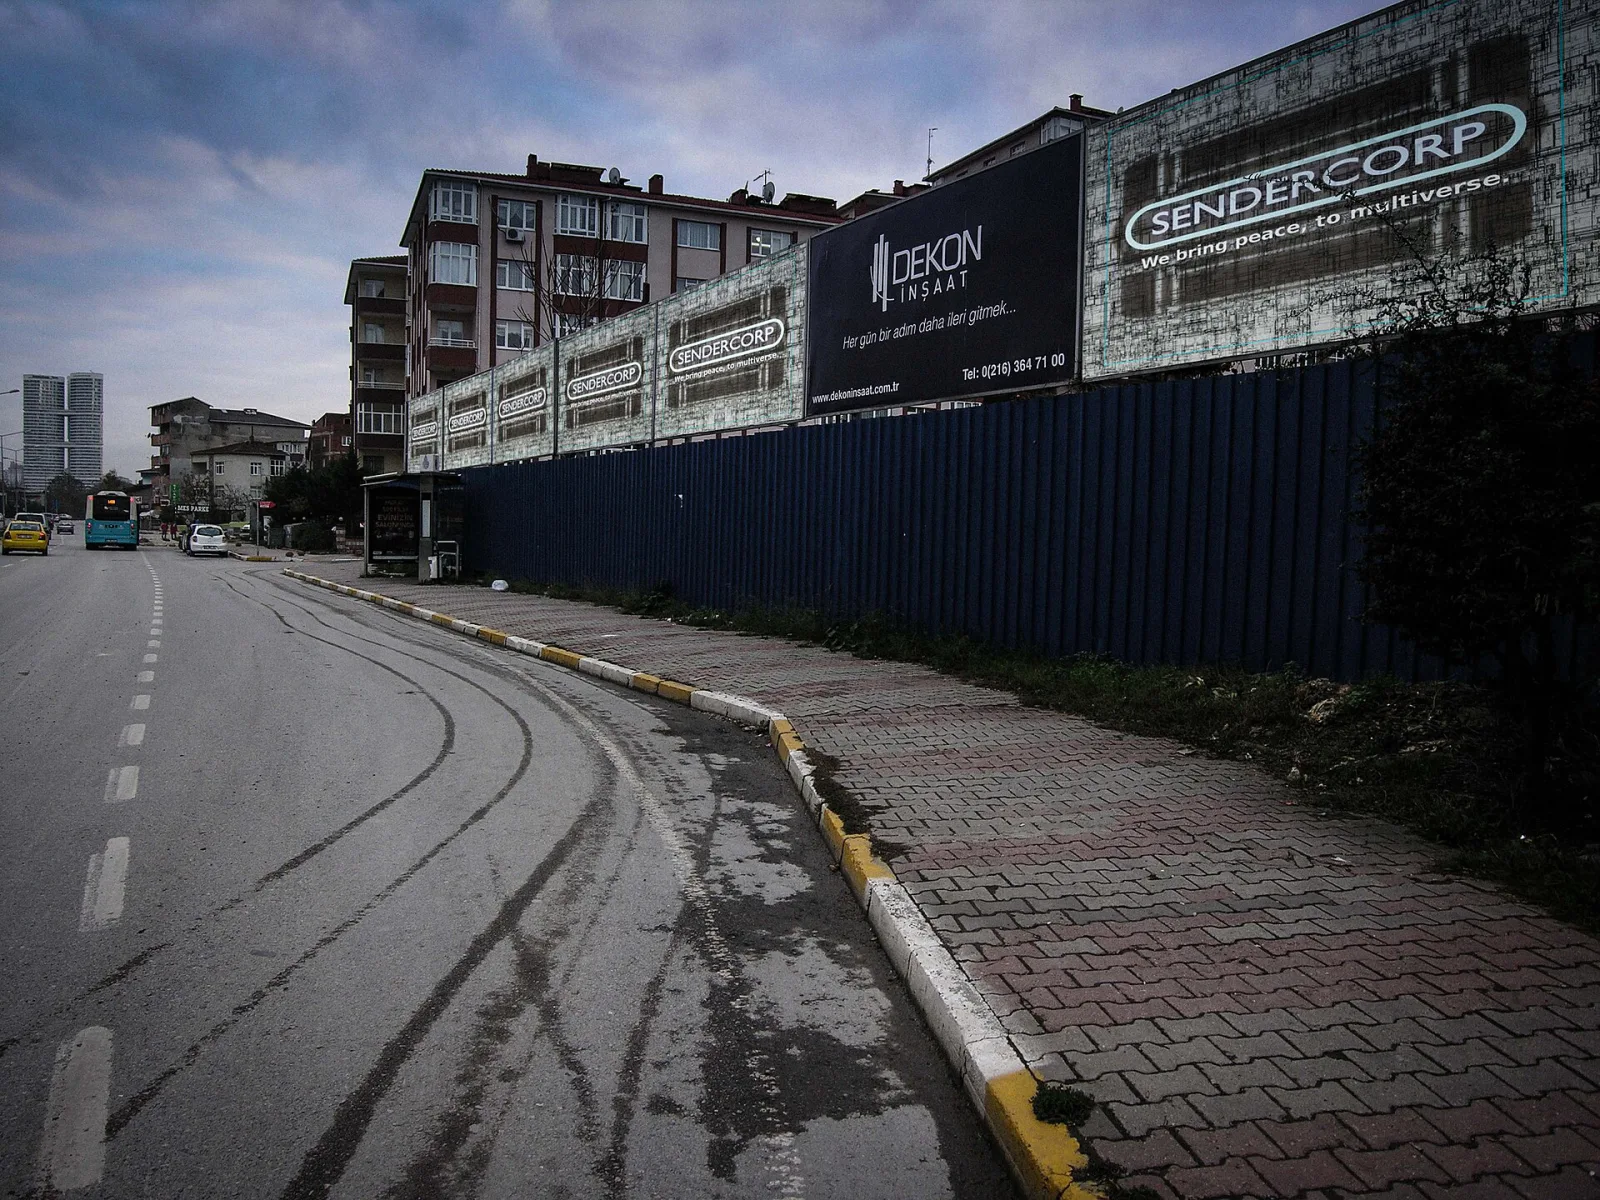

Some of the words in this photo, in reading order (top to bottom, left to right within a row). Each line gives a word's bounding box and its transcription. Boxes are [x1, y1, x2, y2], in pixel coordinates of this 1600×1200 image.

[1151, 121, 1486, 236] SENDERCORP
[1141, 251, 1170, 270] We
[1176, 239, 1227, 262] bring
[1236, 220, 1307, 250] peace,
[1315, 213, 1341, 228] to
[1350, 173, 1509, 220] multiverse.
[892, 225, 983, 285] DEKON
[900, 270, 968, 303] İNŞAAT
[842, 336, 859, 350] Her
[859, 331, 877, 350] gün
[879, 327, 891, 343] bir
[892, 323, 917, 339] adım
[918, 315, 945, 334] daha
[947, 308, 968, 328] ileri
[968, 299, 1017, 326] gitmek...
[677, 326, 775, 366] SENDERCORP
[572, 367, 636, 395] SENDERCORP
[685, 371, 703, 381] bring
[727, 362, 735, 370] to
[962, 368, 980, 381] Tel:
[981, 361, 1011, 380] 0(216)
[1013, 357, 1033, 373] 364
[1034, 355, 1048, 370] 71
[1051, 352, 1066, 368] 00
[502, 391, 543, 413] SENDERCORP
[812, 381, 900, 404] www.dekoninsaat.com.tr
